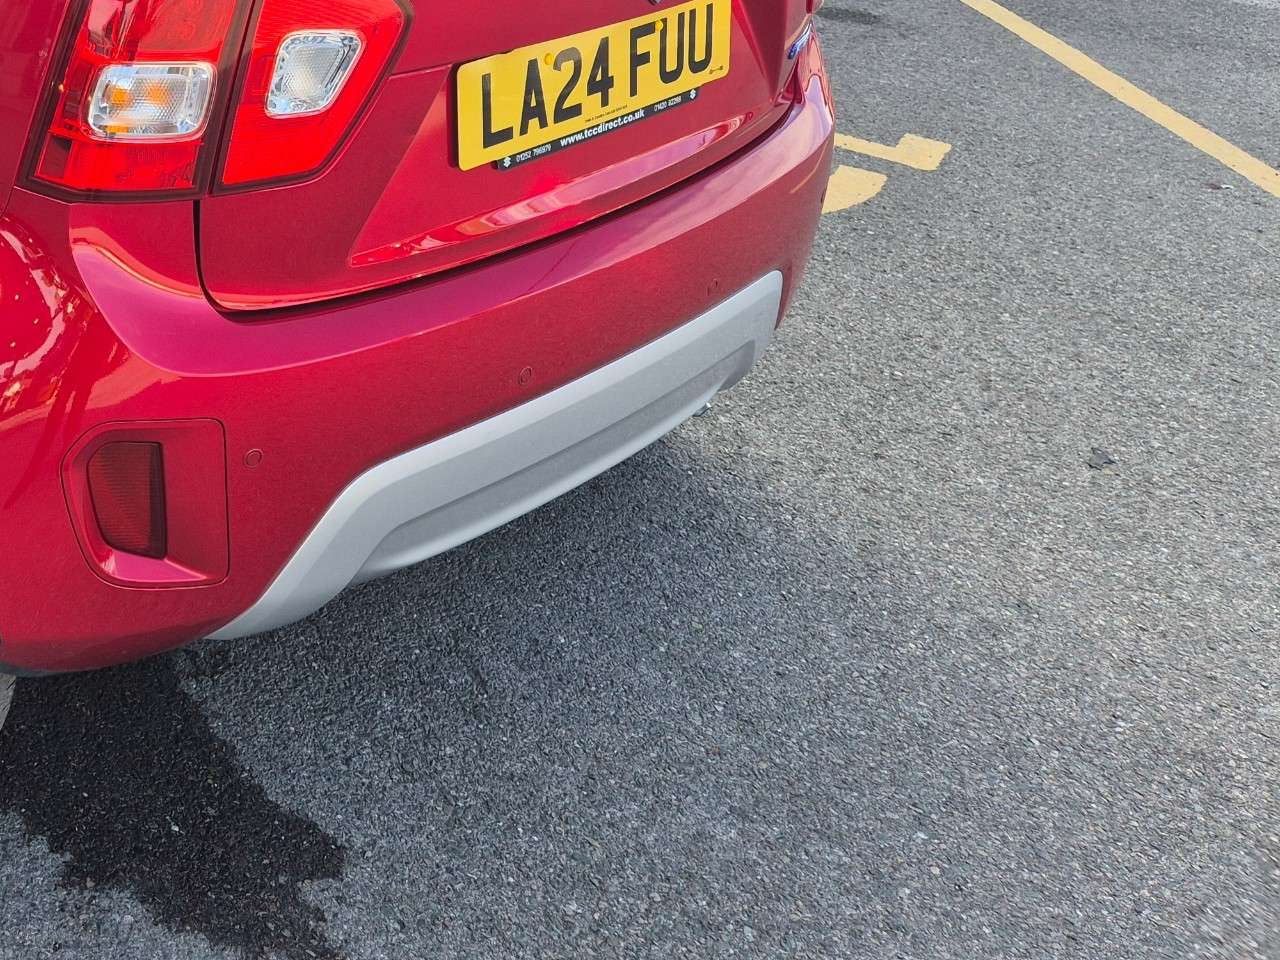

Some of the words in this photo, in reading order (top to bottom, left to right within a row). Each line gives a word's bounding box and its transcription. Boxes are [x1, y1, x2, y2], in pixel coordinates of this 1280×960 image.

[481, 37, 615, 149] LA24
[629, 3, 715, 98] FUU
[560, 109, 645, 147] www.tccdirect.co.uk
